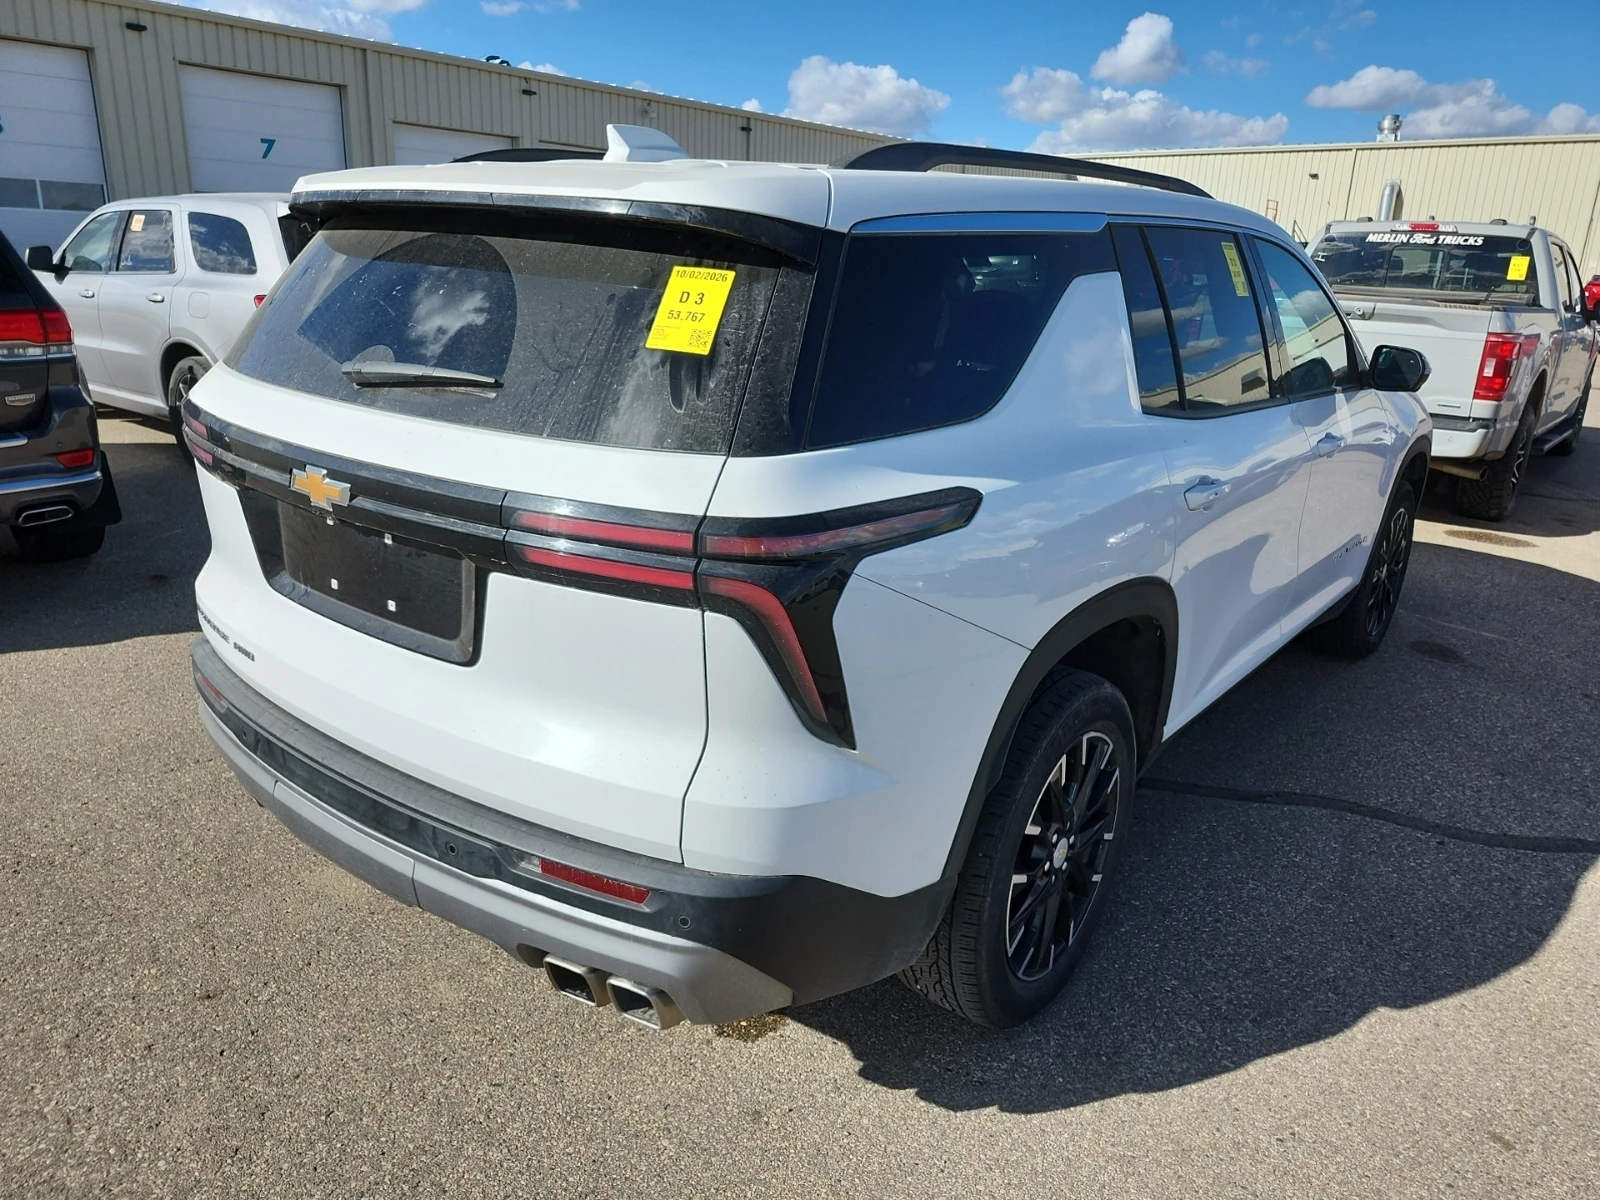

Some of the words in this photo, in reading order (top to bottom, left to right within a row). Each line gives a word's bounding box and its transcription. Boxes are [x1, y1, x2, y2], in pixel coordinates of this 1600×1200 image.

[260, 137, 276, 159] 7
[1365, 233, 1410, 243] MERLIN
[1409, 233, 1437, 244] Ford
[1437, 235, 1485, 246] TRUCKS
[675, 269, 728, 283] 10/02/2026
[679, 291, 690, 304] D
[694, 292, 705, 305] 3
